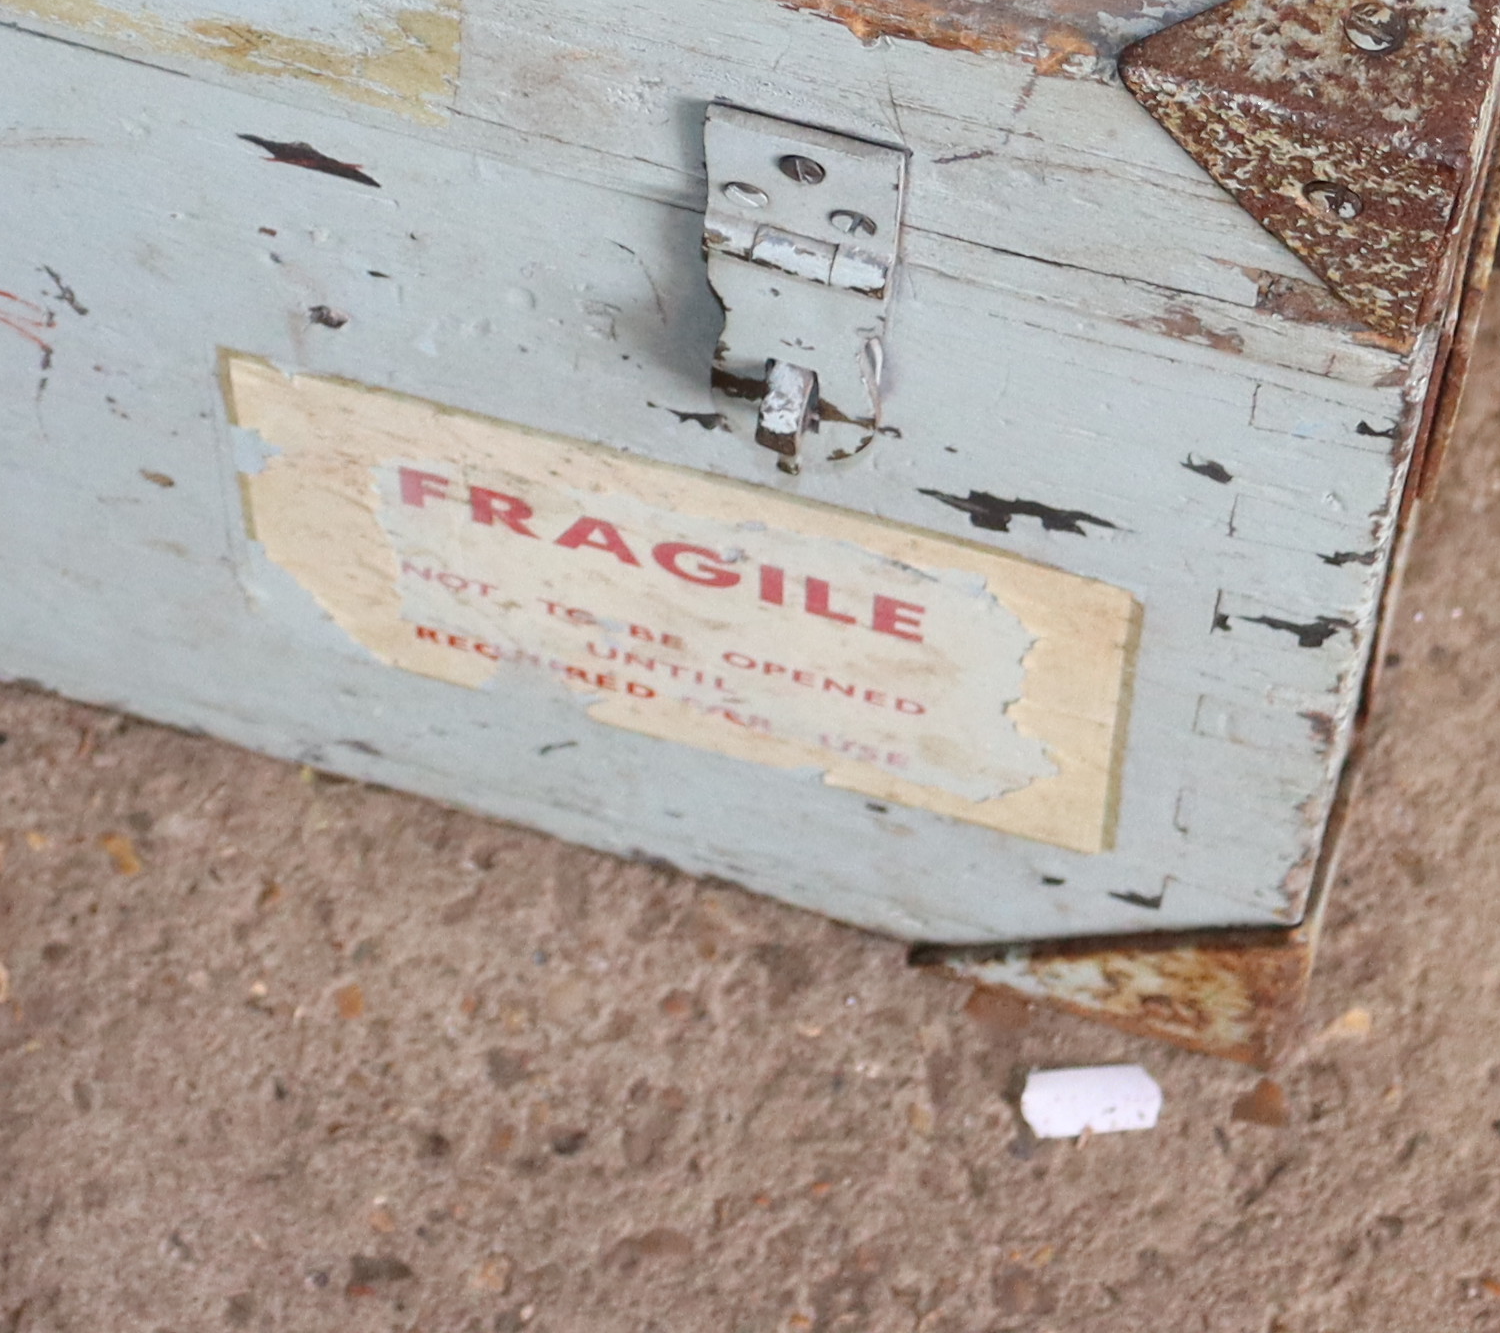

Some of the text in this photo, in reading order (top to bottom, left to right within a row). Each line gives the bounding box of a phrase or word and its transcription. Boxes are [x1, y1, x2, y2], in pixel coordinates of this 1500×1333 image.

[399, 466, 926, 645] FRAGILE
[402, 561, 498, 597] NOT
[629, 623, 685, 649] BE
[721, 650, 927, 716] OPENED
[587, 640, 738, 694] UNTIL
